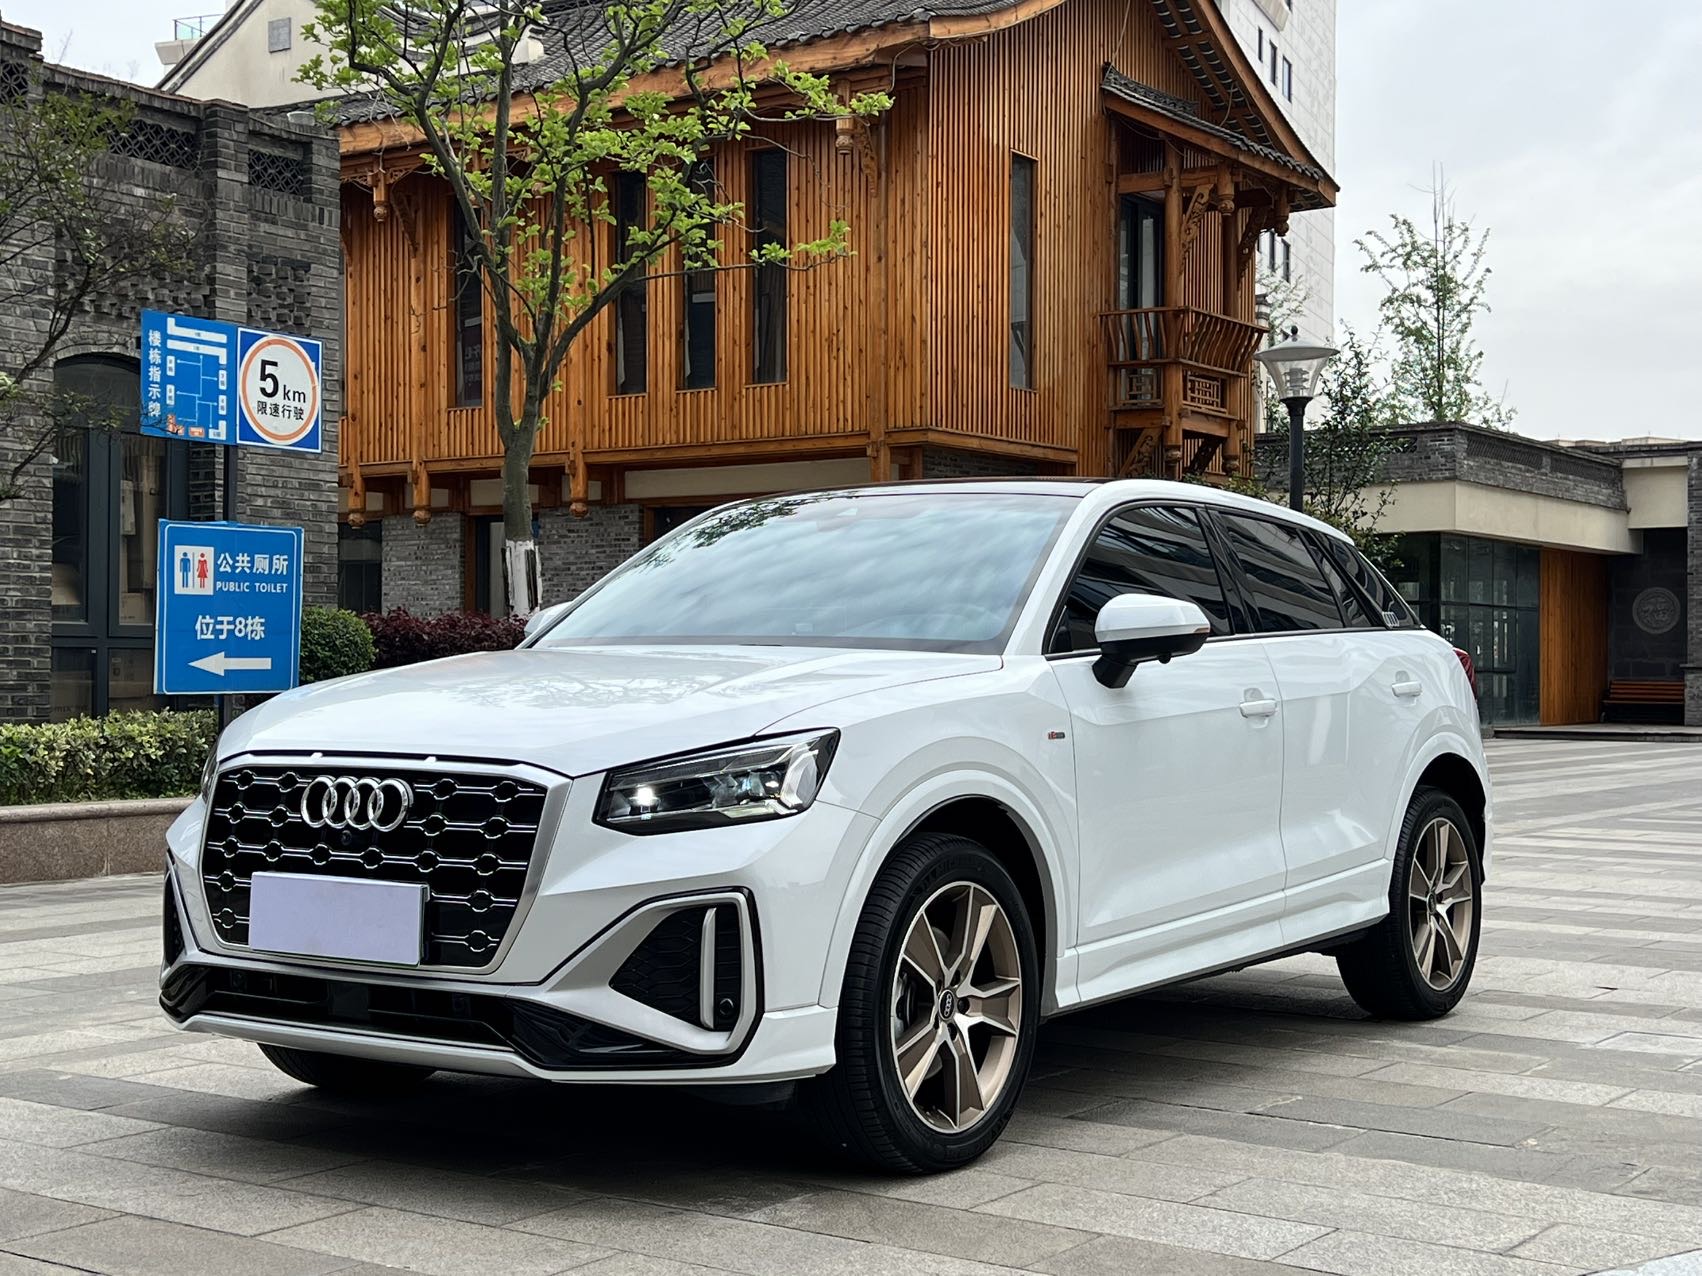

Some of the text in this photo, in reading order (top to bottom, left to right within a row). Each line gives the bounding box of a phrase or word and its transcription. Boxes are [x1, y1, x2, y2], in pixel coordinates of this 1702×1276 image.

[147, 329, 162, 417] 楼栋指示牌
[256, 400, 305, 421] 限速行驶
[217, 552, 289, 575] 公共厕所
[216, 581, 288, 593] PUBLIC TOILET
[195, 615, 266, 641] 位于8栋
